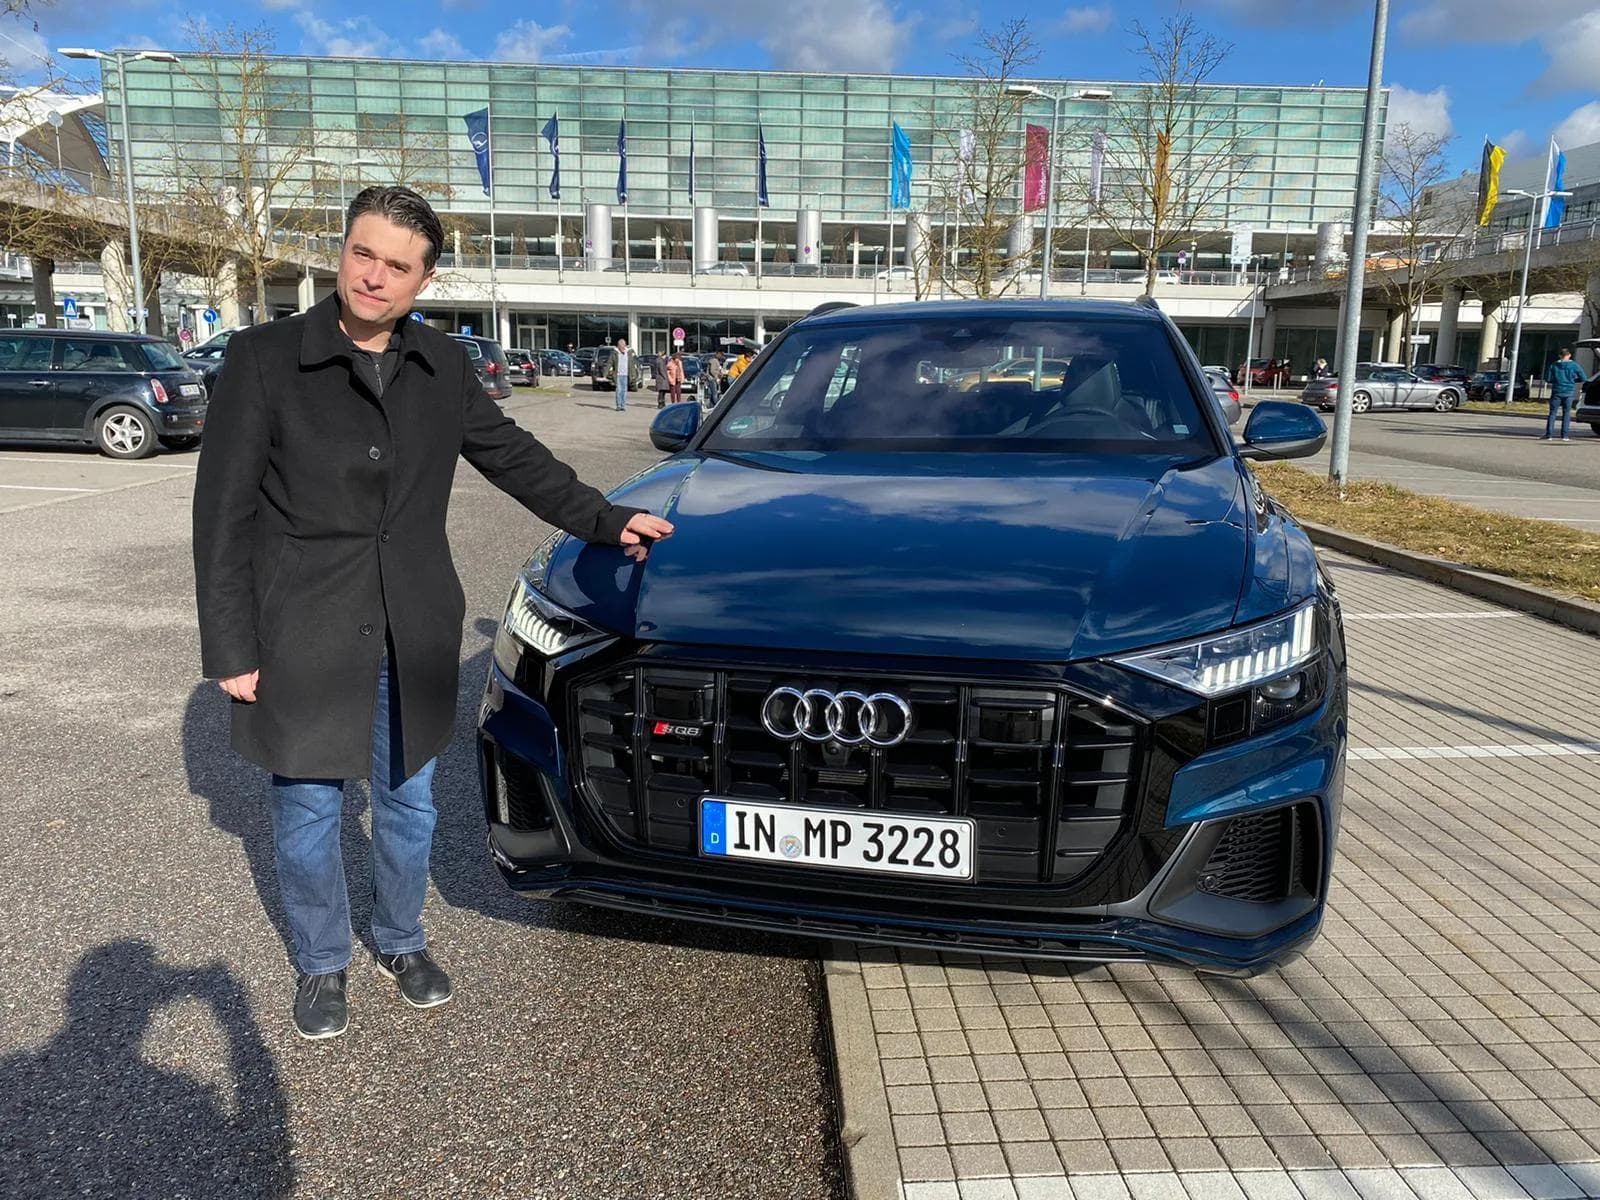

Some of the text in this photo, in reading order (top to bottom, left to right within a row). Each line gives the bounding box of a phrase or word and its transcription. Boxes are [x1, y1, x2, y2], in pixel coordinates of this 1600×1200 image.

[711, 832, 719, 843] D
[733, 811, 962, 869] IN MP 3228
